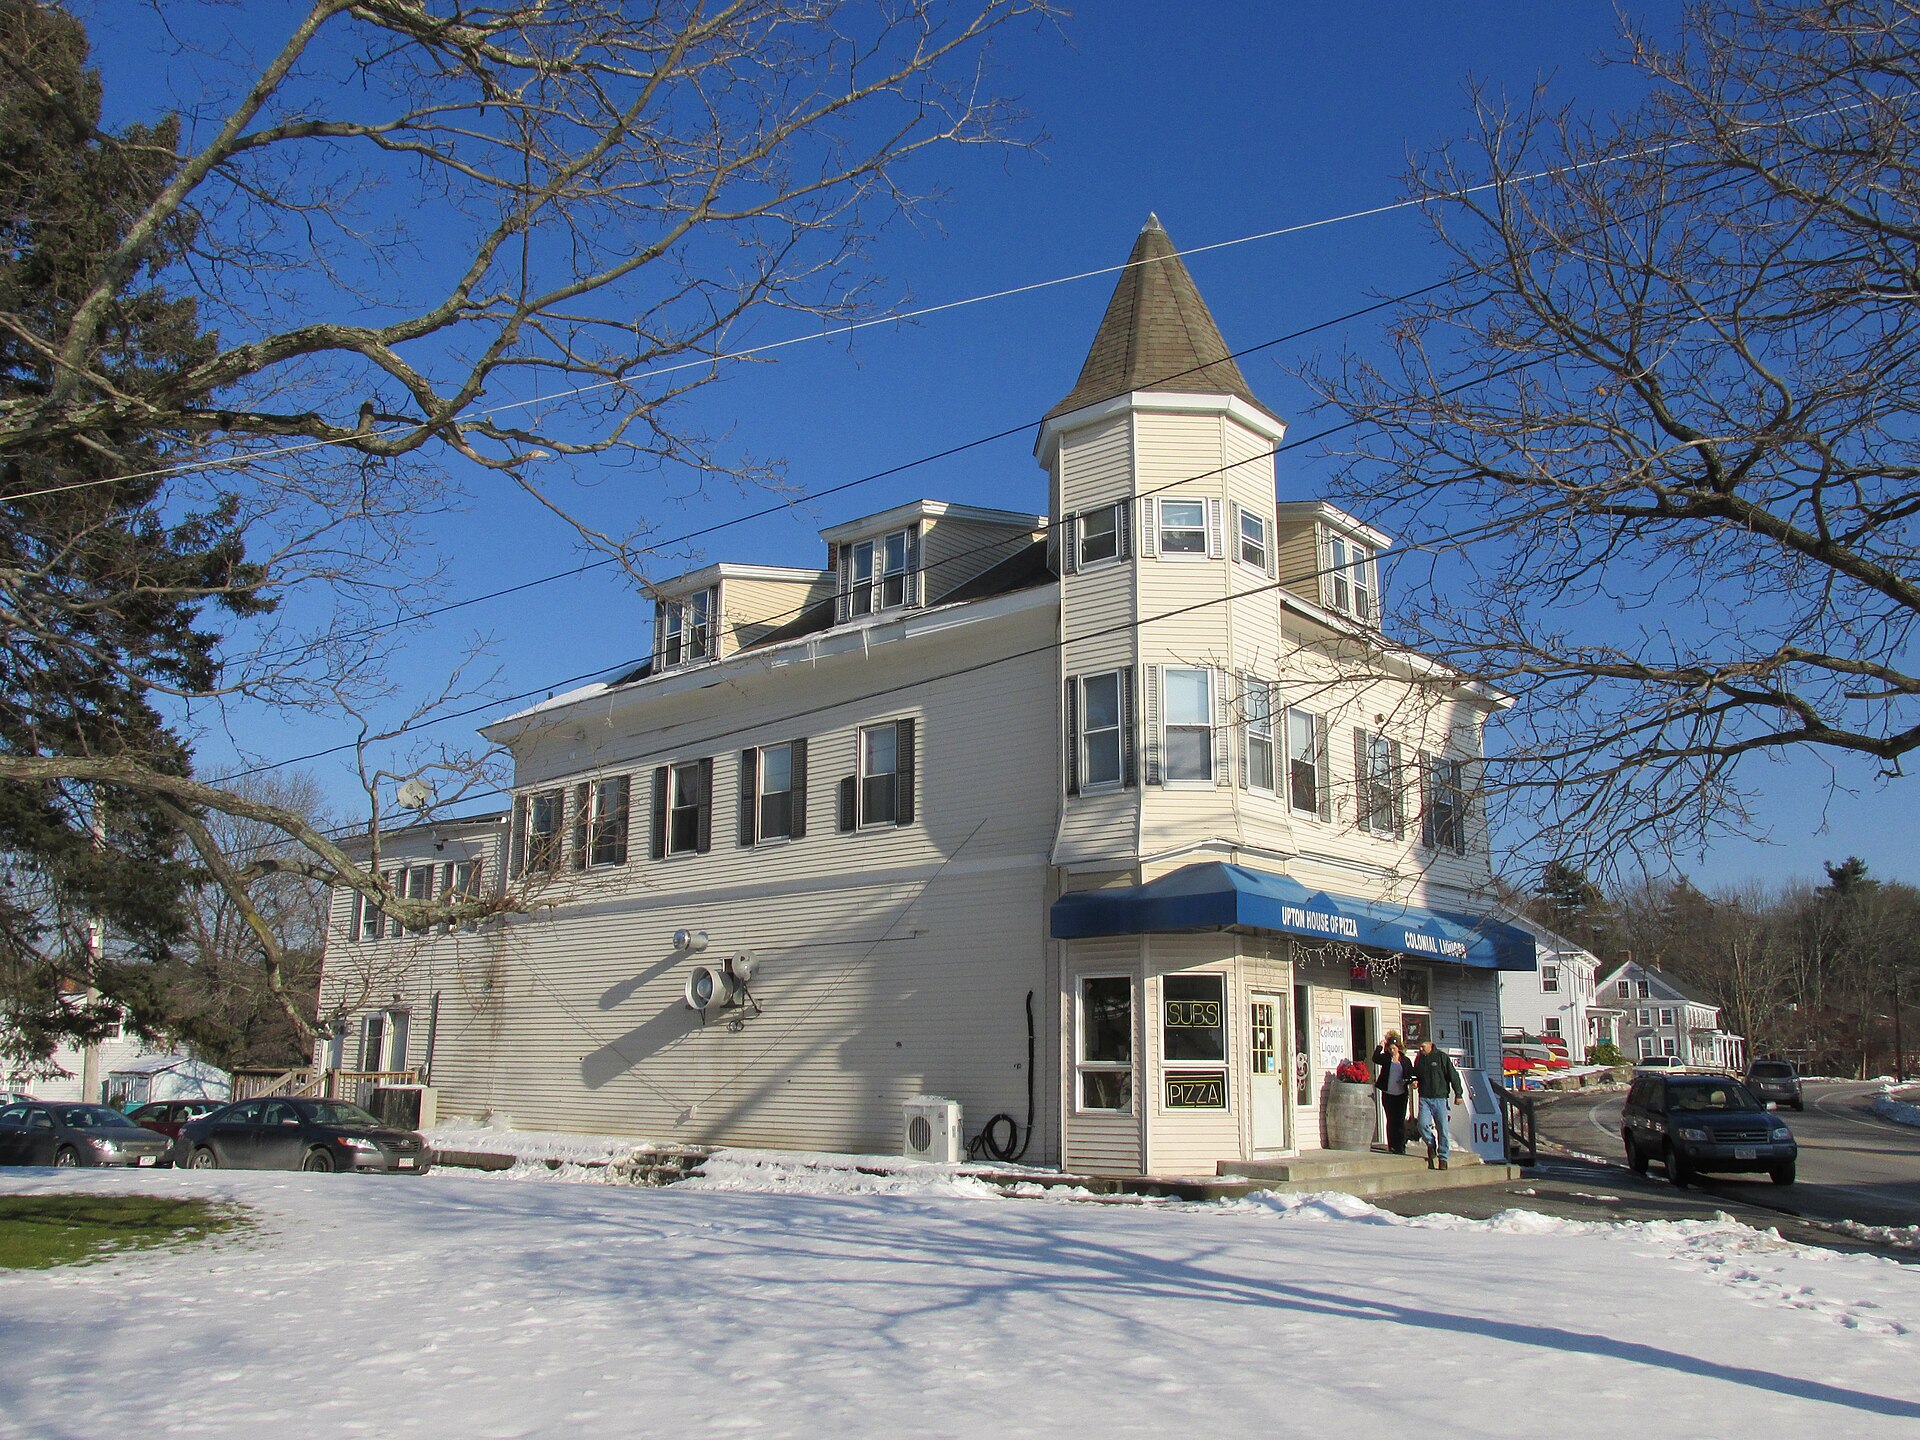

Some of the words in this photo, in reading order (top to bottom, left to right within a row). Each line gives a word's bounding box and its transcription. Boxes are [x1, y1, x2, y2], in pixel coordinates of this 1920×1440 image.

[1281, 906, 1305, 929] UPTON
[1306, 910, 1330, 933] HOUSE
[1329, 914, 1339, 934] OF
[1339, 916, 1358, 938] PIZZA
[1404, 931, 1438, 954] COLONIAL
[1167, 1003, 1218, 1026] SUBS
[1320, 1026, 1345, 1039] Colonial
[1321, 1041, 1344, 1056] Liquors
[1169, 1083, 1219, 1104] PIZZA
[1473, 1120, 1500, 1144] ICE
